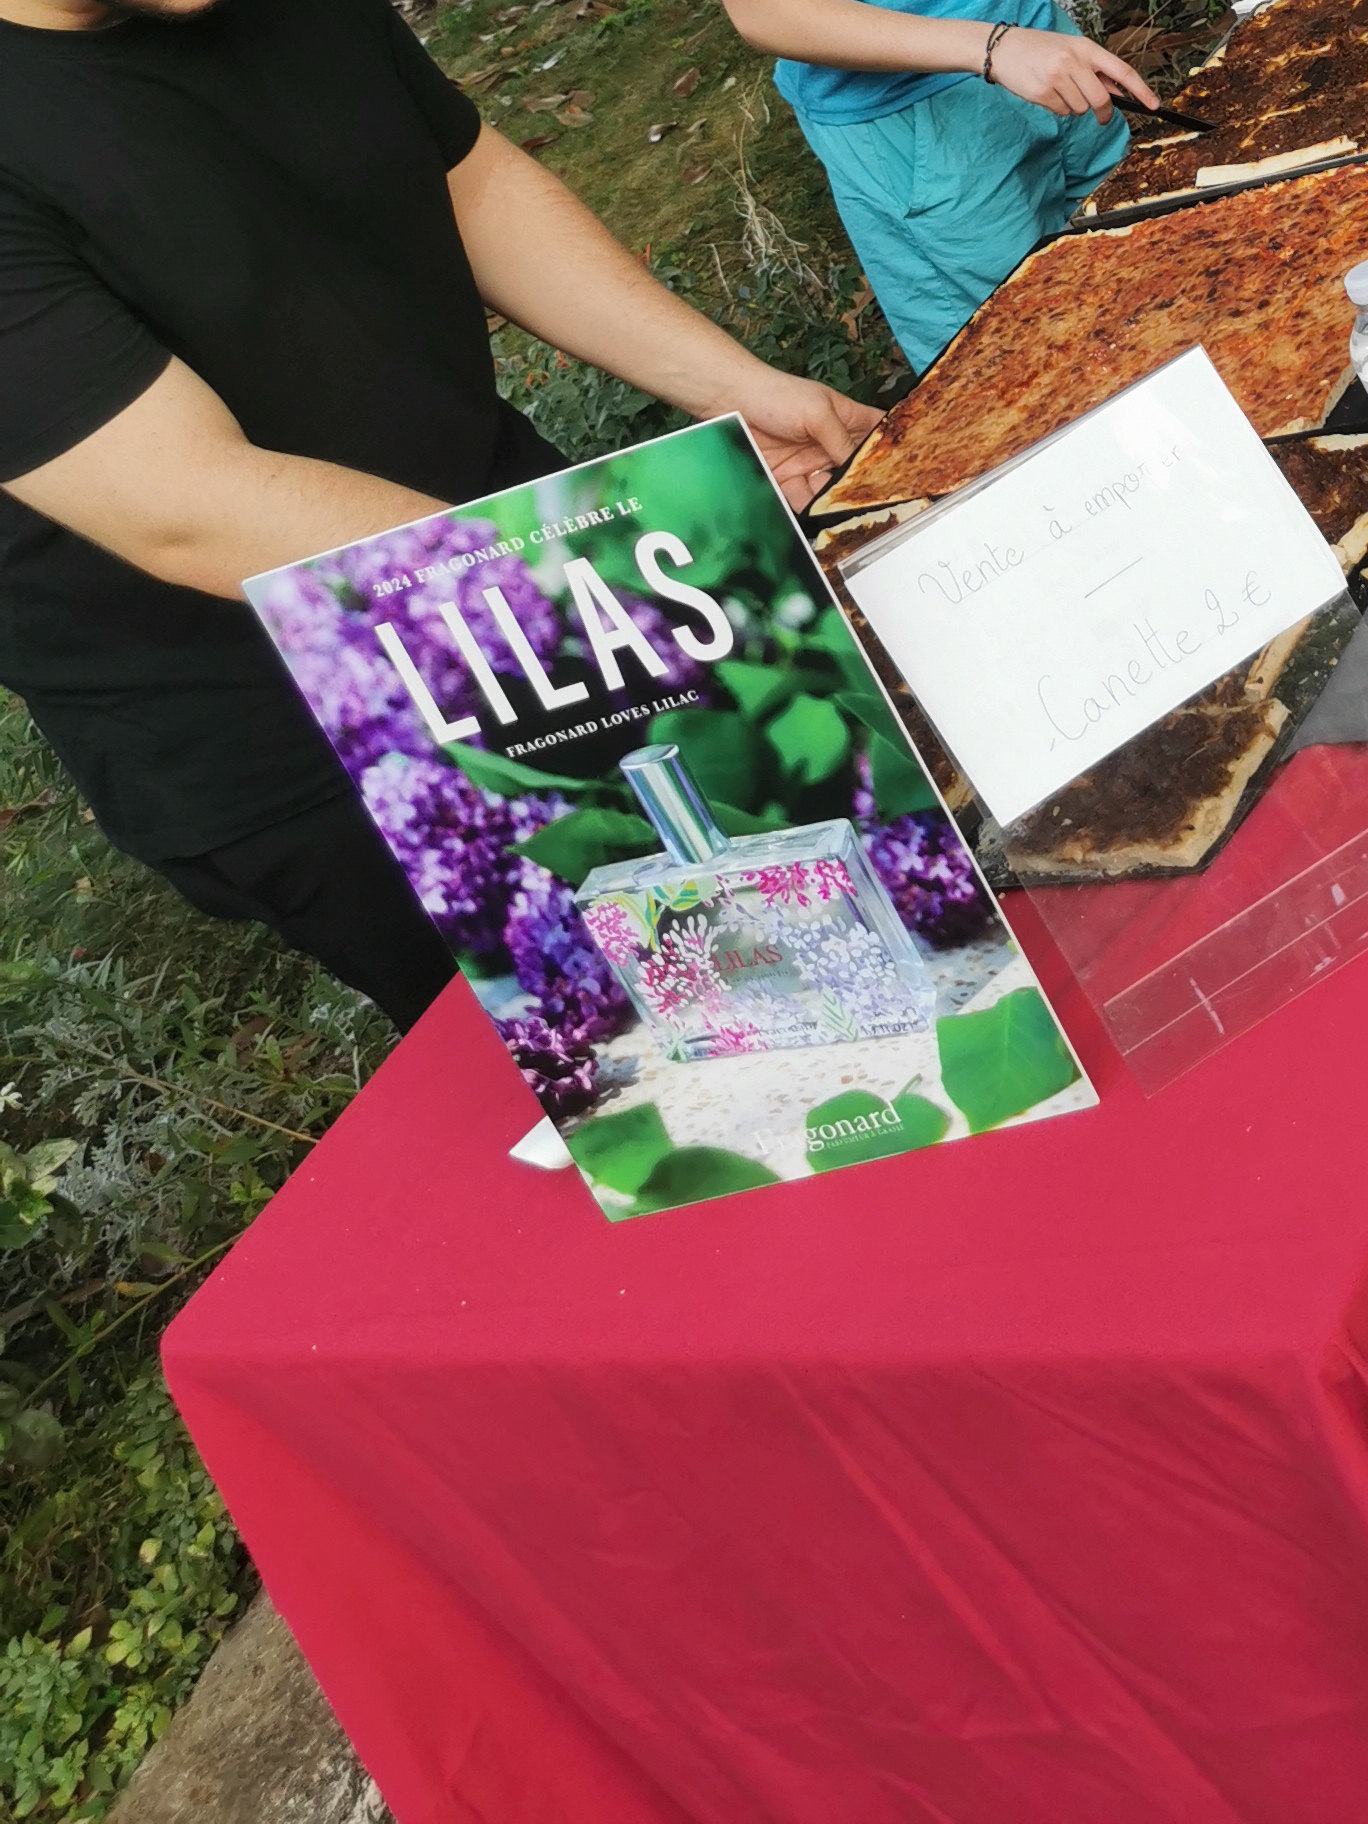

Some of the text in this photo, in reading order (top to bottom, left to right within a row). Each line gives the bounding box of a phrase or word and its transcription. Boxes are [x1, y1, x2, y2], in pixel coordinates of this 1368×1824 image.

[373, 496, 644, 597] 2024 FRAGONARD CÉLÈBRE LE
[918, 544, 1025, 605] Vente
[1043, 505, 1072, 540] à
[374, 531, 734, 744] LILAS
[1038, 618, 1202, 752] Canette
[506, 689, 700, 758] FRAGONARD LOVES LILAC
[713, 944, 783, 972] LILAS
